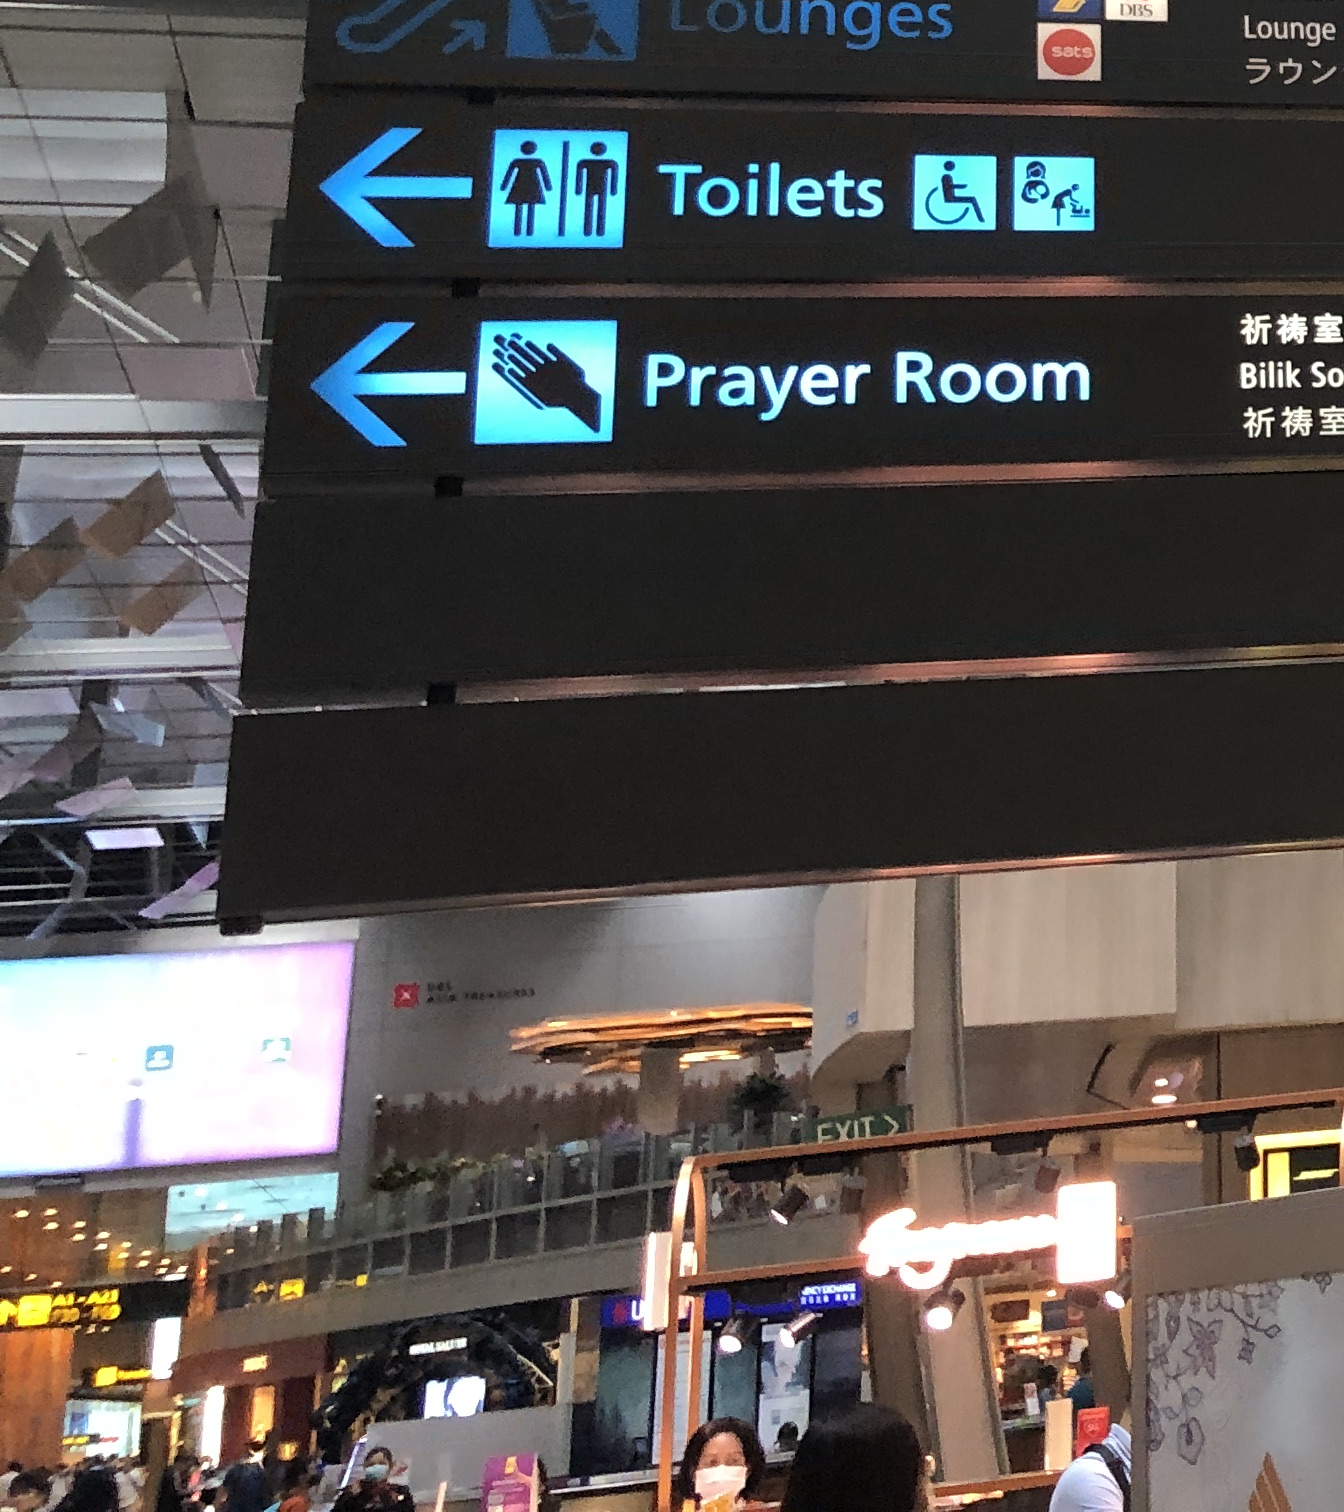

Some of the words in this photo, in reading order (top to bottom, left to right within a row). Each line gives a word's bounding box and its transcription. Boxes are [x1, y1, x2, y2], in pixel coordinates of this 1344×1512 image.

[1119, 2, 1154, 18] DBS
[1244, 15, 1336, 47] Lounge
[1051, 44, 1093, 59] sats
[658, 162, 884, 218] Toilets
[1240, 312, 1344, 345] 祈祷室
[644, 353, 871, 421] Prayer
[894, 351, 1090, 403] Room
[1240, 361, 1301, 389] Bilik
